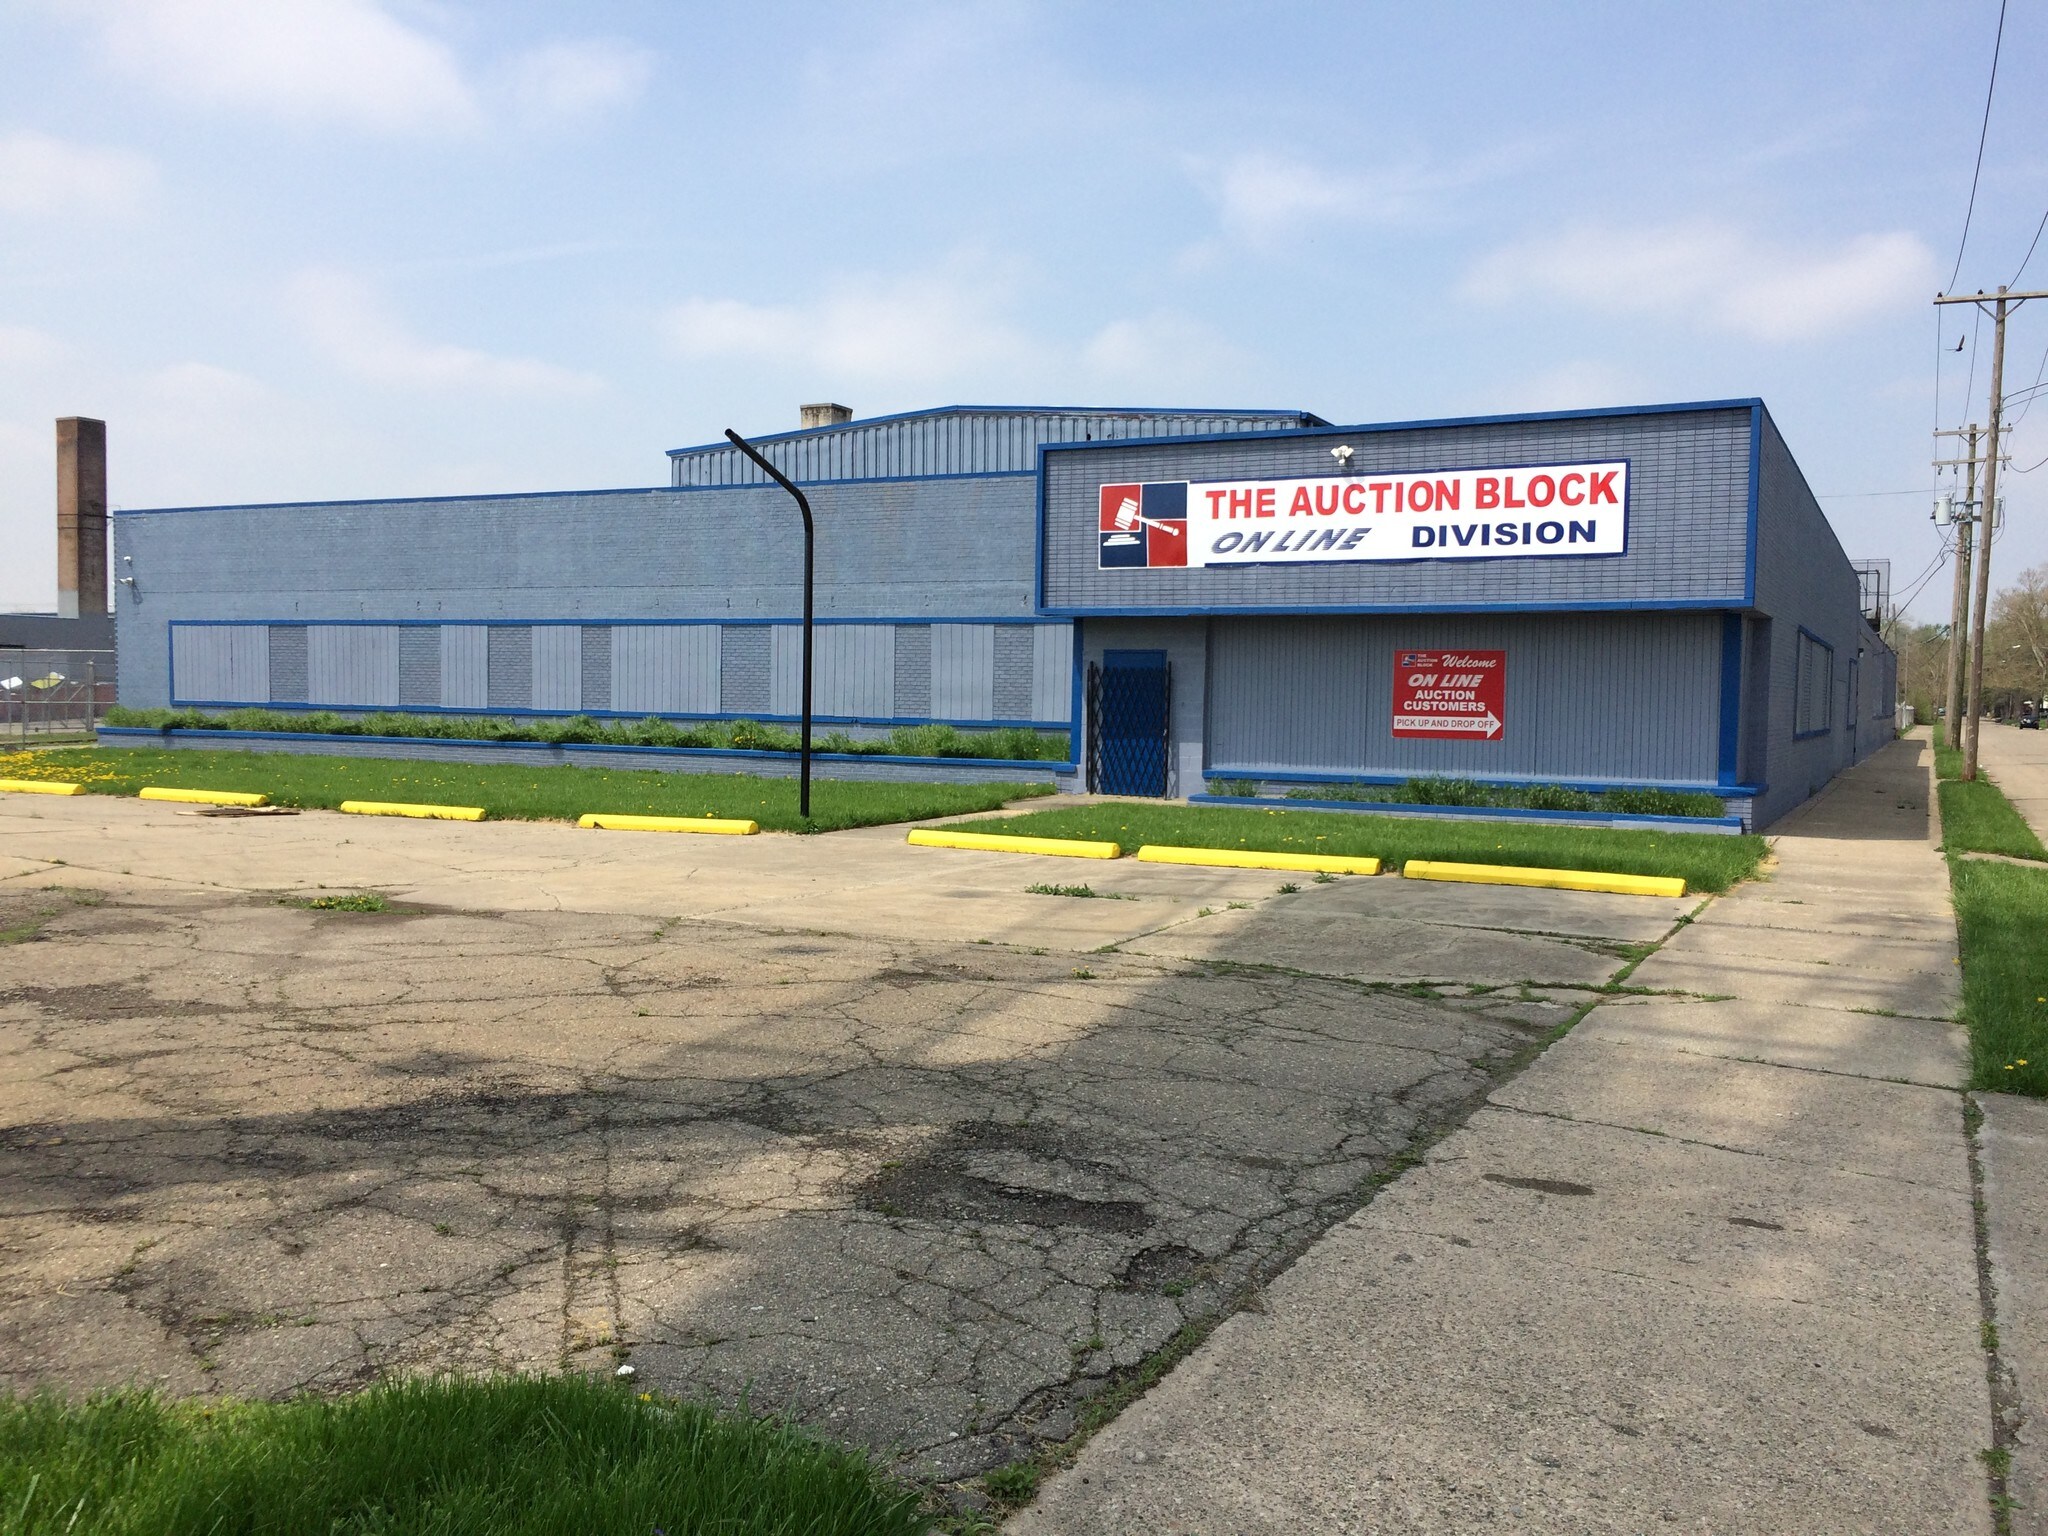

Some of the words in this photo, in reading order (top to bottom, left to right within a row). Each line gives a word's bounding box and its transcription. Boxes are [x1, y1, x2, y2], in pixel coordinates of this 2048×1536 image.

[1205, 488, 1276, 519] THE
[1289, 479, 1460, 517] AUCTION
[1475, 471, 1619, 510] BLOCK
[1412, 520, 1596, 548] DIVISION
[1441, 654, 1497, 668] Welcome
[1408, 674, 1438, 687] ON
[1440, 674, 1484, 687] LINE
[1415, 690, 1475, 700] AUCTION
[1403, 701, 1486, 712] CUSTOMERS
[1396, 718, 1416, 727] PICK
[1418, 718, 1429, 727] UP
[1431, 719, 1449, 727] AND
[1451, 719, 1475, 728] DROP
[1477, 720, 1495, 729] OFF
